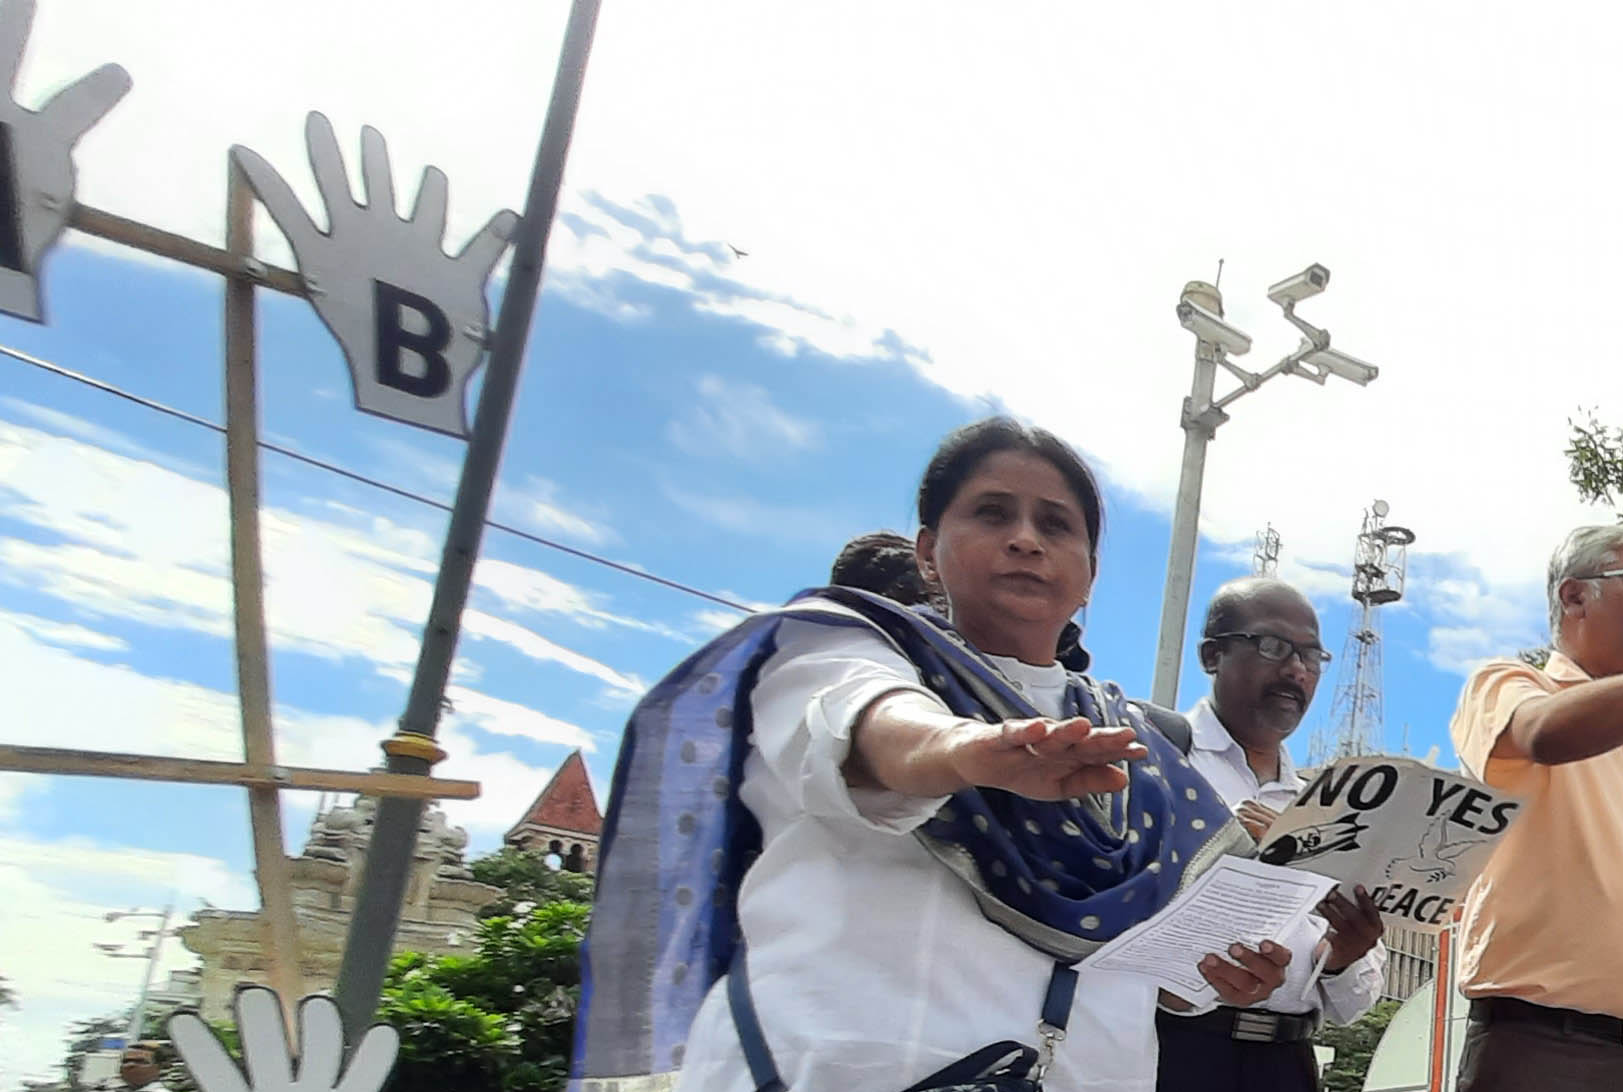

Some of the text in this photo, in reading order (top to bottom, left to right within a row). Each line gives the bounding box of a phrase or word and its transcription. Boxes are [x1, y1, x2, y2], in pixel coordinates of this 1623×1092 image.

[373, 279, 452, 398] B
[1295, 765, 1519, 835] NO YES
[1370, 883, 1455, 925] PEACE
